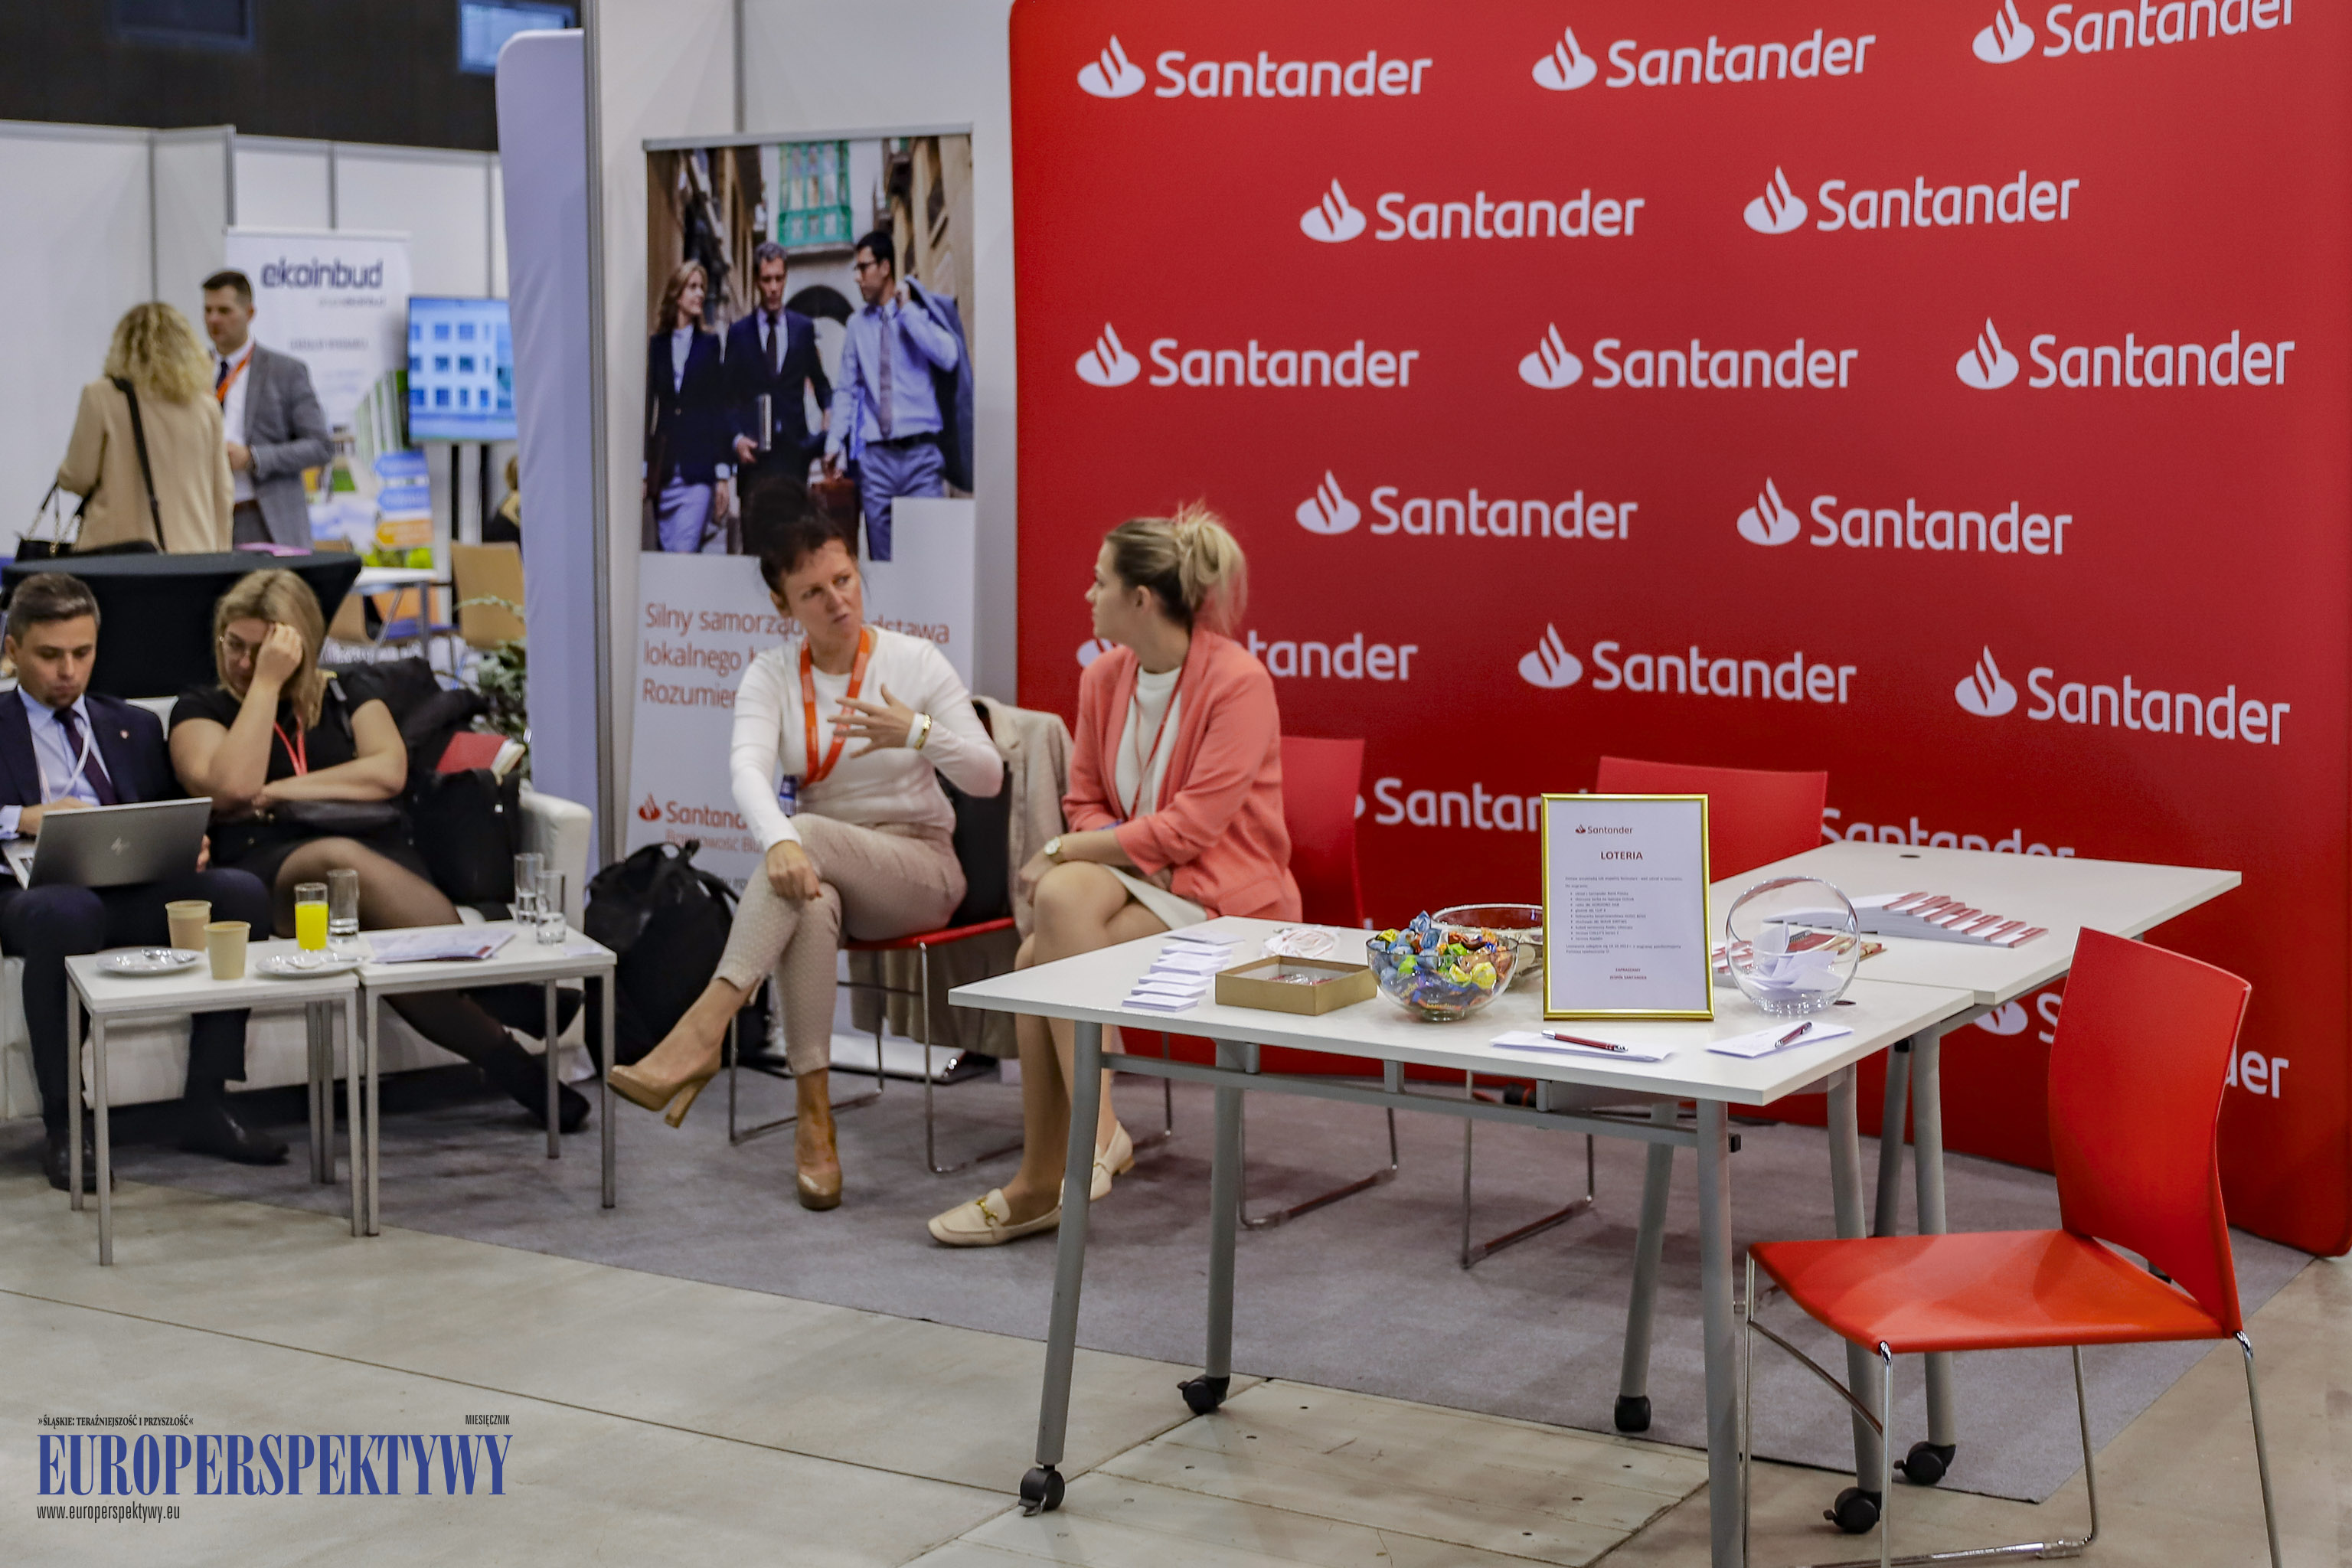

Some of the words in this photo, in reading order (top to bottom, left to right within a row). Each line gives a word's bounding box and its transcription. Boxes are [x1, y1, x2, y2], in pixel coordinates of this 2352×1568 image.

[1155, 50, 1433, 98] Santander
[1606, 28, 1877, 88] Santander
[1375, 188, 1645, 241] Santander
[1816, 169, 2080, 231] Santander
[260, 256, 384, 288] ekoinbud
[1149, 338, 1419, 387] Santander
[1592, 338, 1859, 389] Santander
[2028, 329, 2295, 388] Santander
[1370, 486, 1638, 539] Santander
[1810, 495, 2073, 555] Santander
[646, 603, 692, 637] Silny
[644, 640, 741, 677] lokalnego
[1247, 630, 1418, 681] tander
[1592, 641, 1857, 703] Santander
[2027, 667, 2291, 745] Santander
[1587, 825, 1633, 835] Santander
[1601, 851, 1643, 861] LOTERIA
